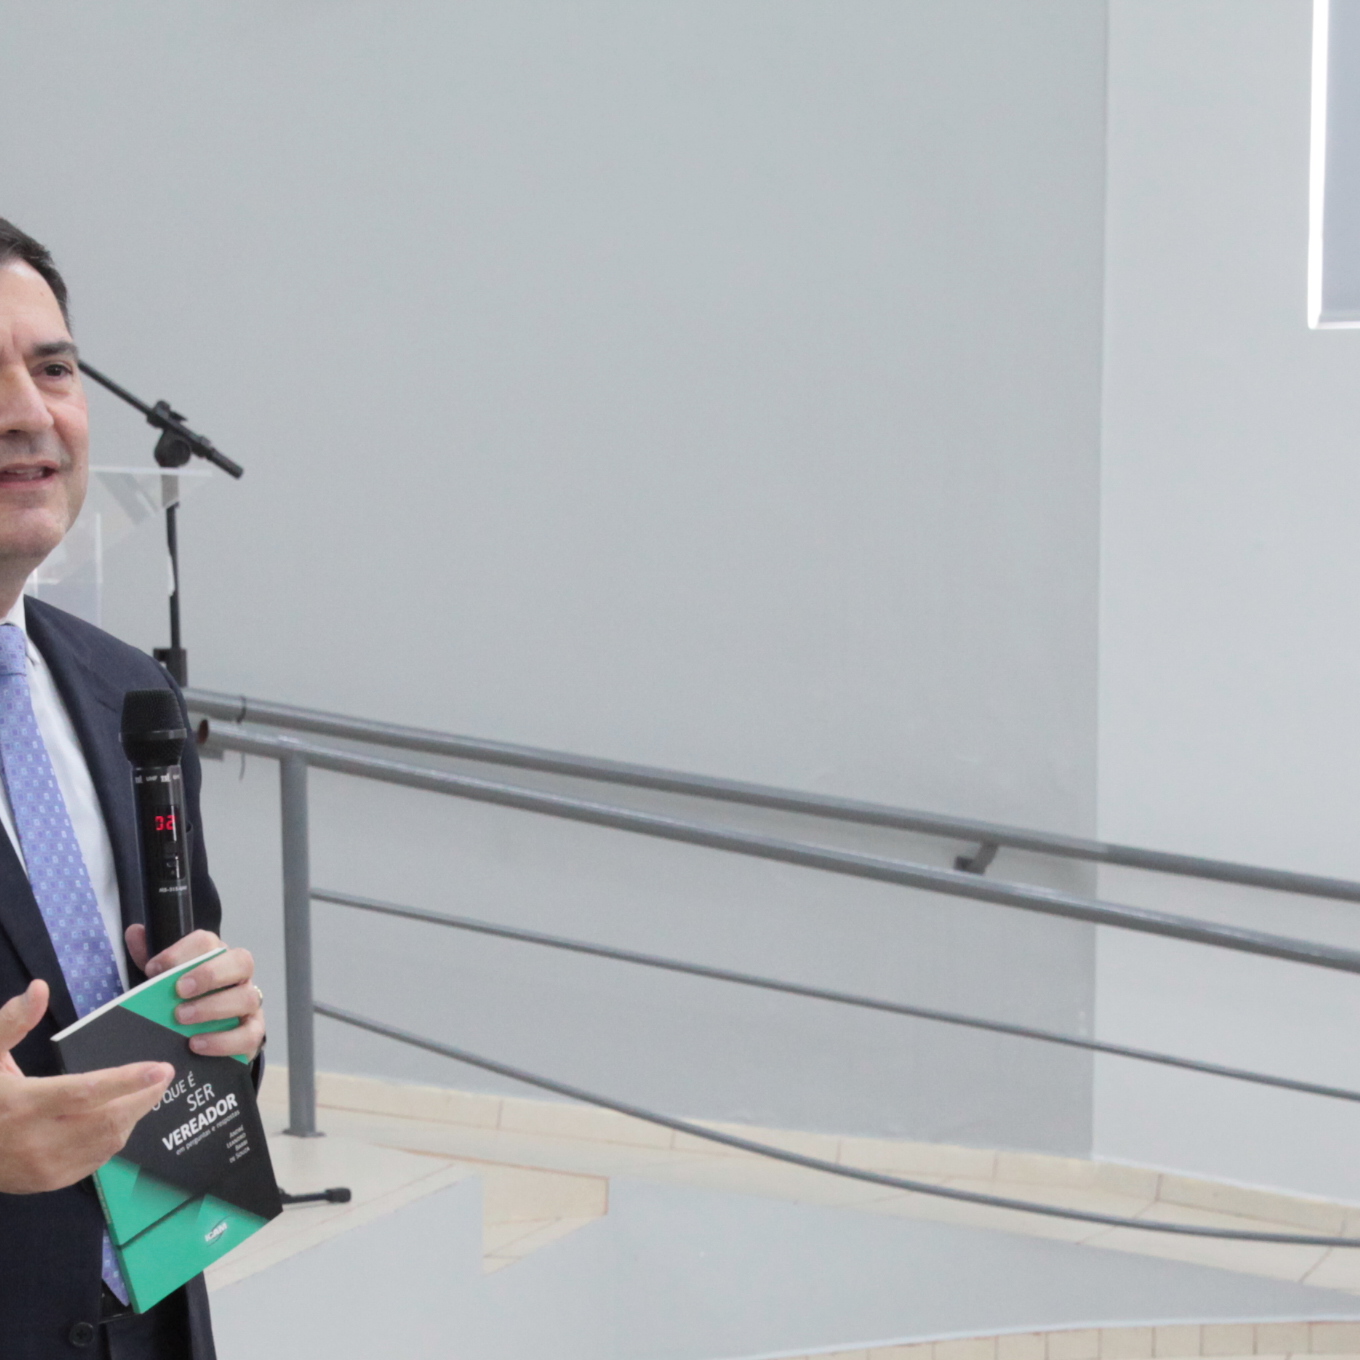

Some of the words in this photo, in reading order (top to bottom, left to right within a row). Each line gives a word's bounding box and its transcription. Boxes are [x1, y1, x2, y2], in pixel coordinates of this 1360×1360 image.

[162, 1080, 187, 1104] QUE
[187, 1070, 196, 1088] É
[186, 1083, 215, 1112] SER
[162, 1093, 238, 1151] VEREADOR
[186, 1129, 211, 1150] perguntas
[216, 1110, 240, 1128] respostas
[204, 1222, 228, 1242] ICAM
